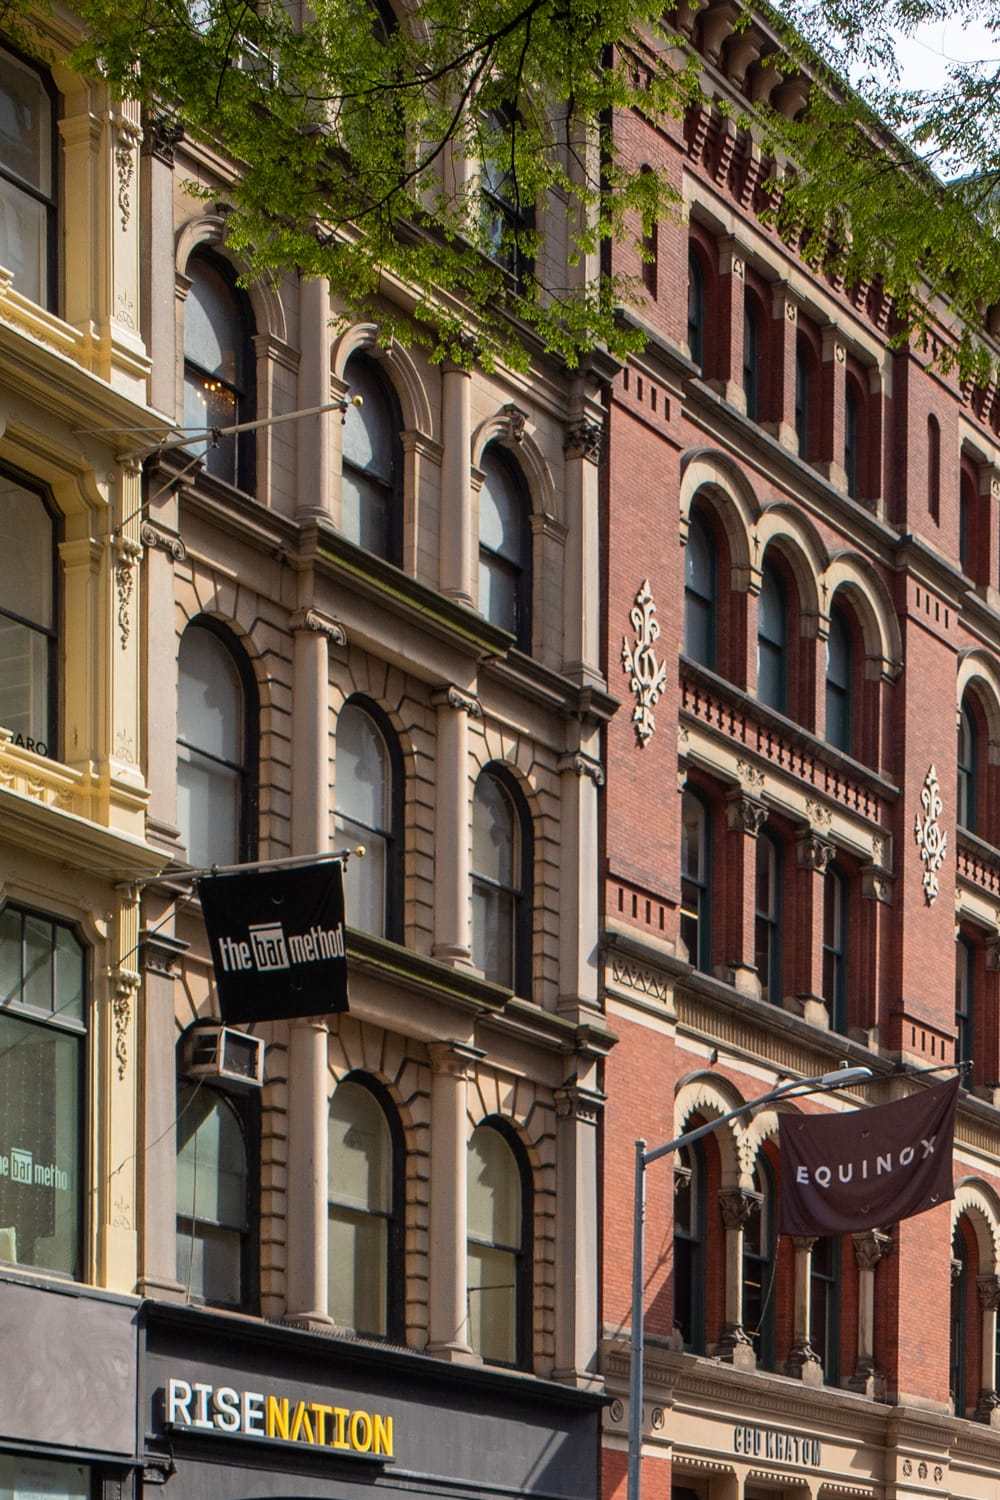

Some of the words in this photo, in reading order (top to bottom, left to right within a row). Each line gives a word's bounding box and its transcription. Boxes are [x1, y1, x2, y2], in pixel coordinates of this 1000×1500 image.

[218, 936, 252, 972] the
[251, 931, 287, 969] bar
[288, 921, 345, 964] method
[12, 1153, 32, 1181] bar
[34, 1163, 70, 1191] metho
[796, 1135, 937, 1188] EQUINOX
[734, 1425, 761, 1456] CBD
[766, 1431, 821, 1467] KRATOM
